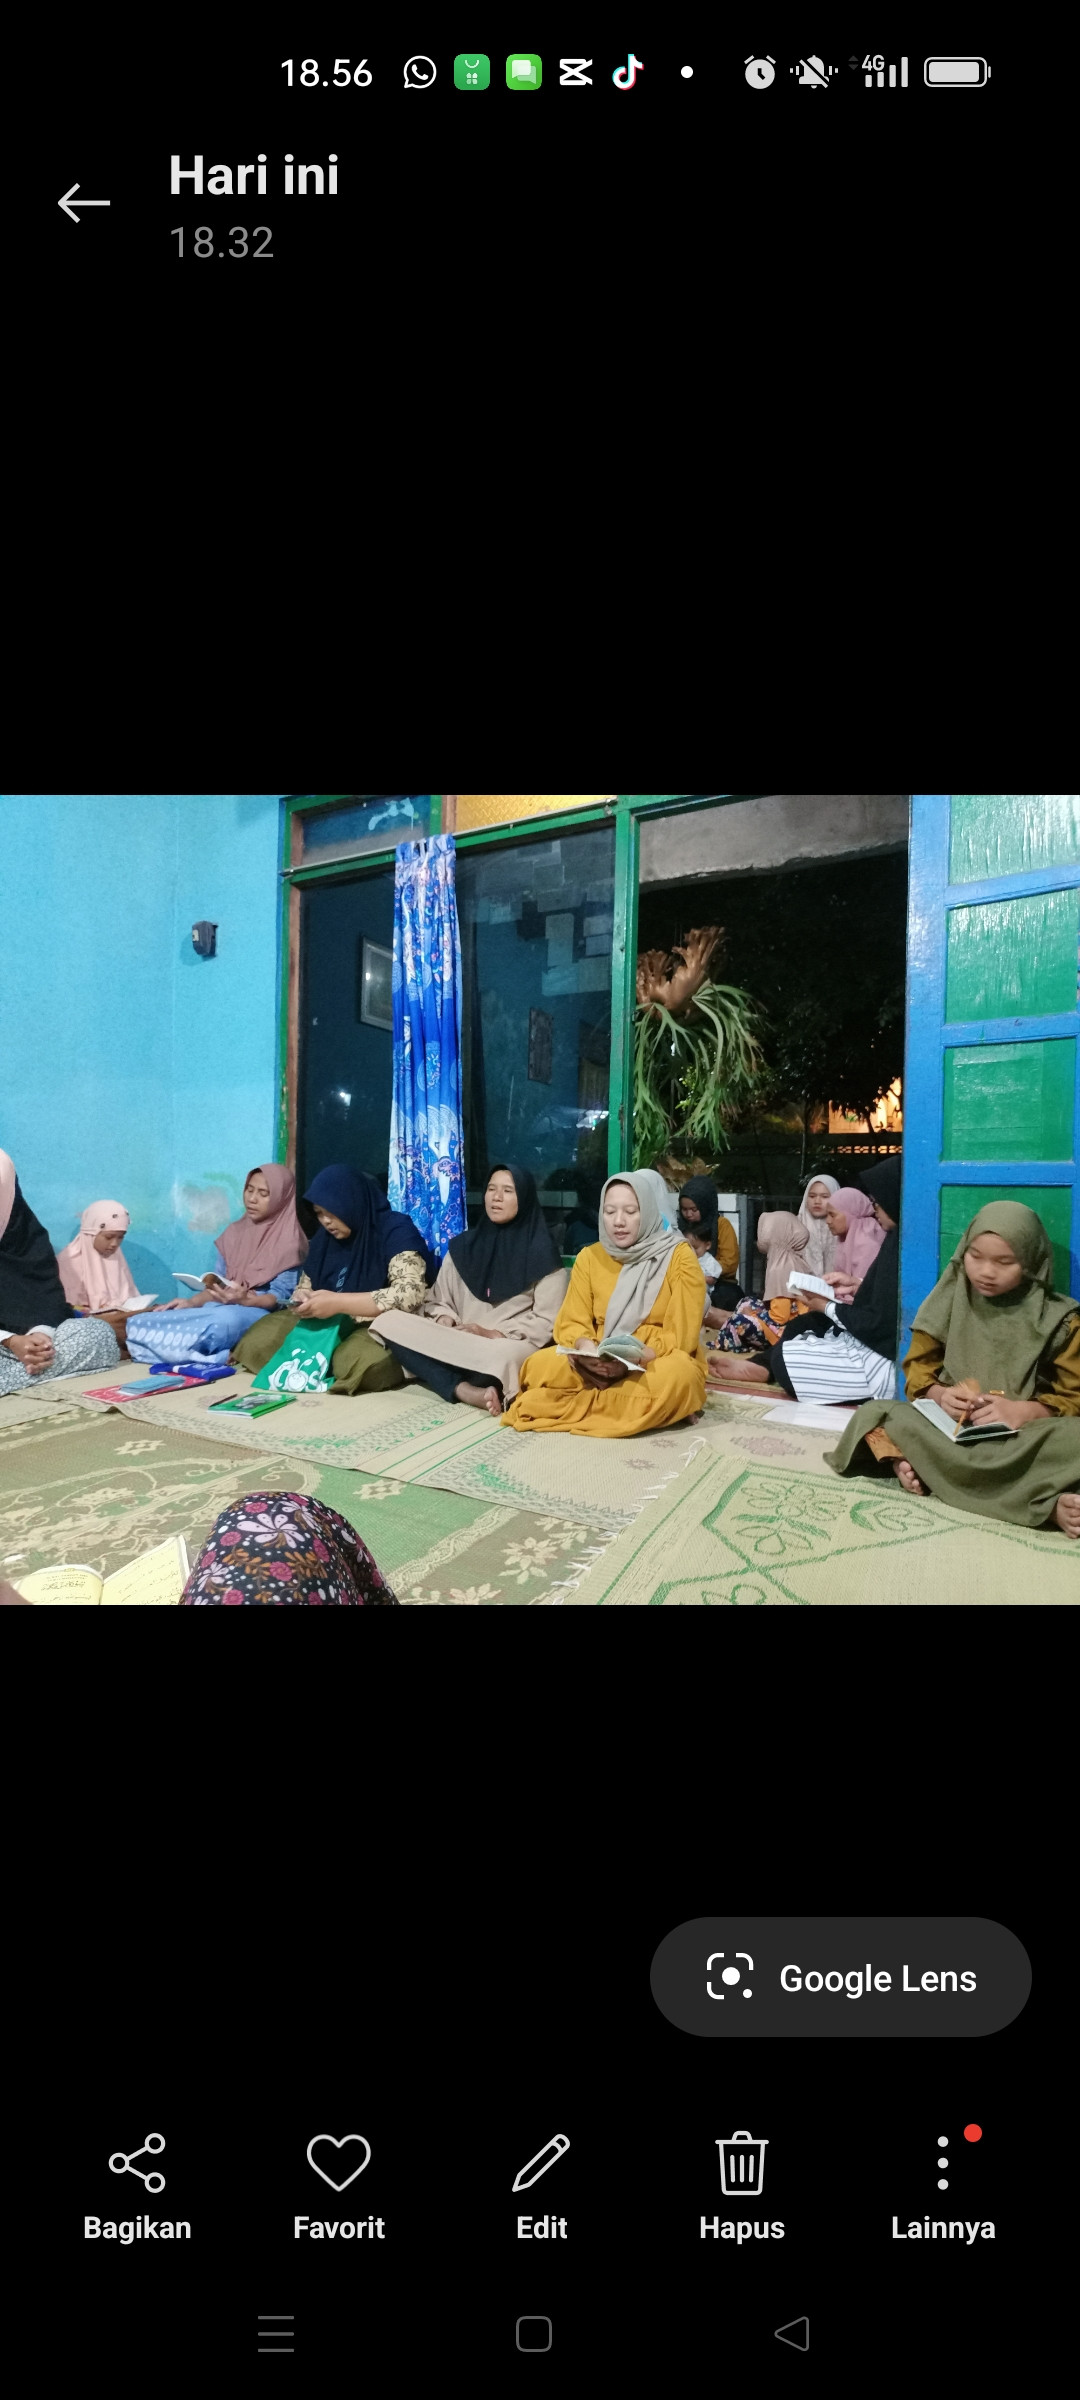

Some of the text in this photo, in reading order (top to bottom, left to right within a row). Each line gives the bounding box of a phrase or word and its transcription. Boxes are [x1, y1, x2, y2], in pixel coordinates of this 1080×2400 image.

[282, 59, 372, 86] 18.56
[862, 55, 885, 71] 4G
[171, 154, 338, 195] Hari ini
[170, 226, 274, 258] 18.32
[781, 1963, 977, 2000] Google Lens
[84, 2214, 192, 2245] Bagikan
[294, 2215, 386, 2240] Favorit
[517, 2214, 568, 2239] Edit
[700, 2215, 785, 2245] Hapus
[892, 2215, 996, 2246] Lainnya
